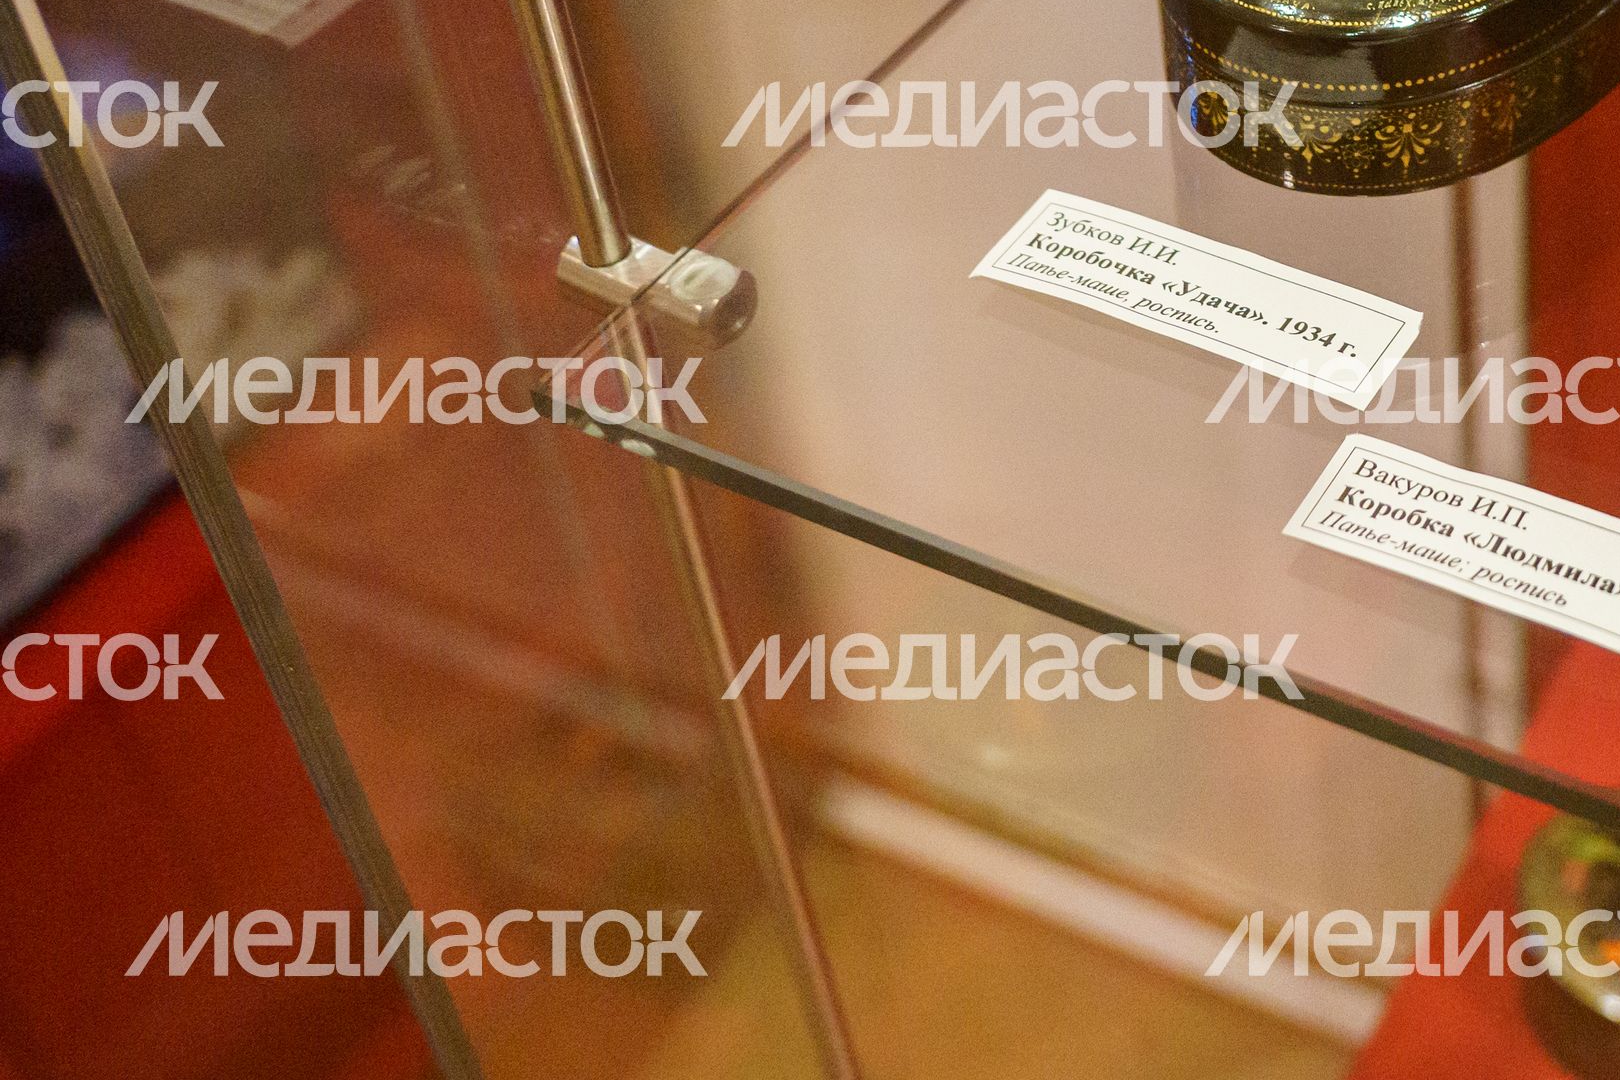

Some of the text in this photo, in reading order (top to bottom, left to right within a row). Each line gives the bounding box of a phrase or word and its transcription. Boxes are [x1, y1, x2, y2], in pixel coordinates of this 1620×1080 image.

[1046, 211, 1181, 266] Зубков И.И.
[1007, 252, 1219, 333] Папье-маше, роспись.
[1025, 232, 1357, 358] Коробочка «Удача». 1934 г.
[1336, 484, 1455, 538] Коробка
[1352, 458, 1530, 531] Вакуров И.П.
[1469, 566, 1568, 607] роспись
